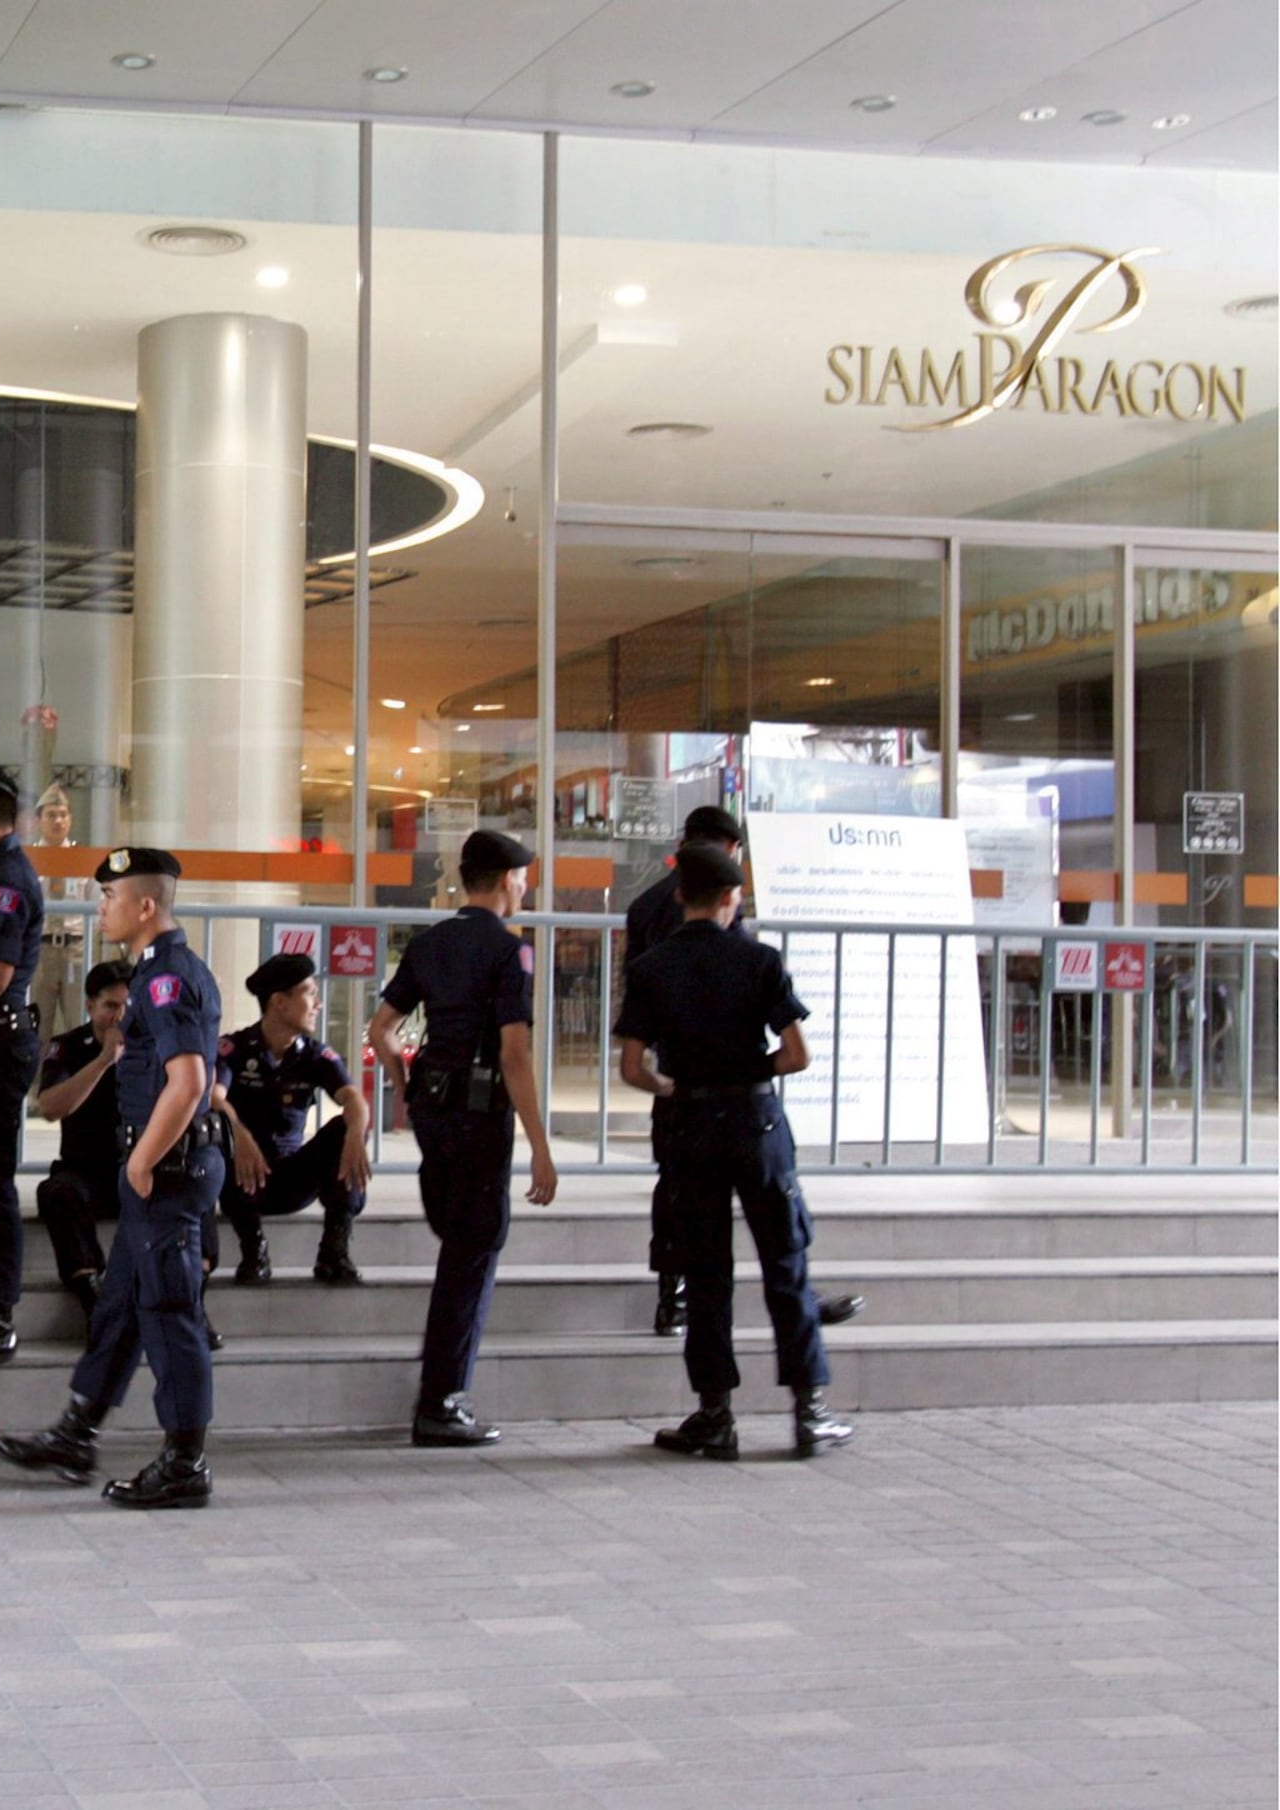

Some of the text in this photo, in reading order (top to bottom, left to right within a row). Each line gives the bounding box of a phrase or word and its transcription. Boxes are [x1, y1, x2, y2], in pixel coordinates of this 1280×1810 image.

[824, 332, 1246, 424] SIAM PARAGON
[969, 568, 1230, 662] McDonld's
